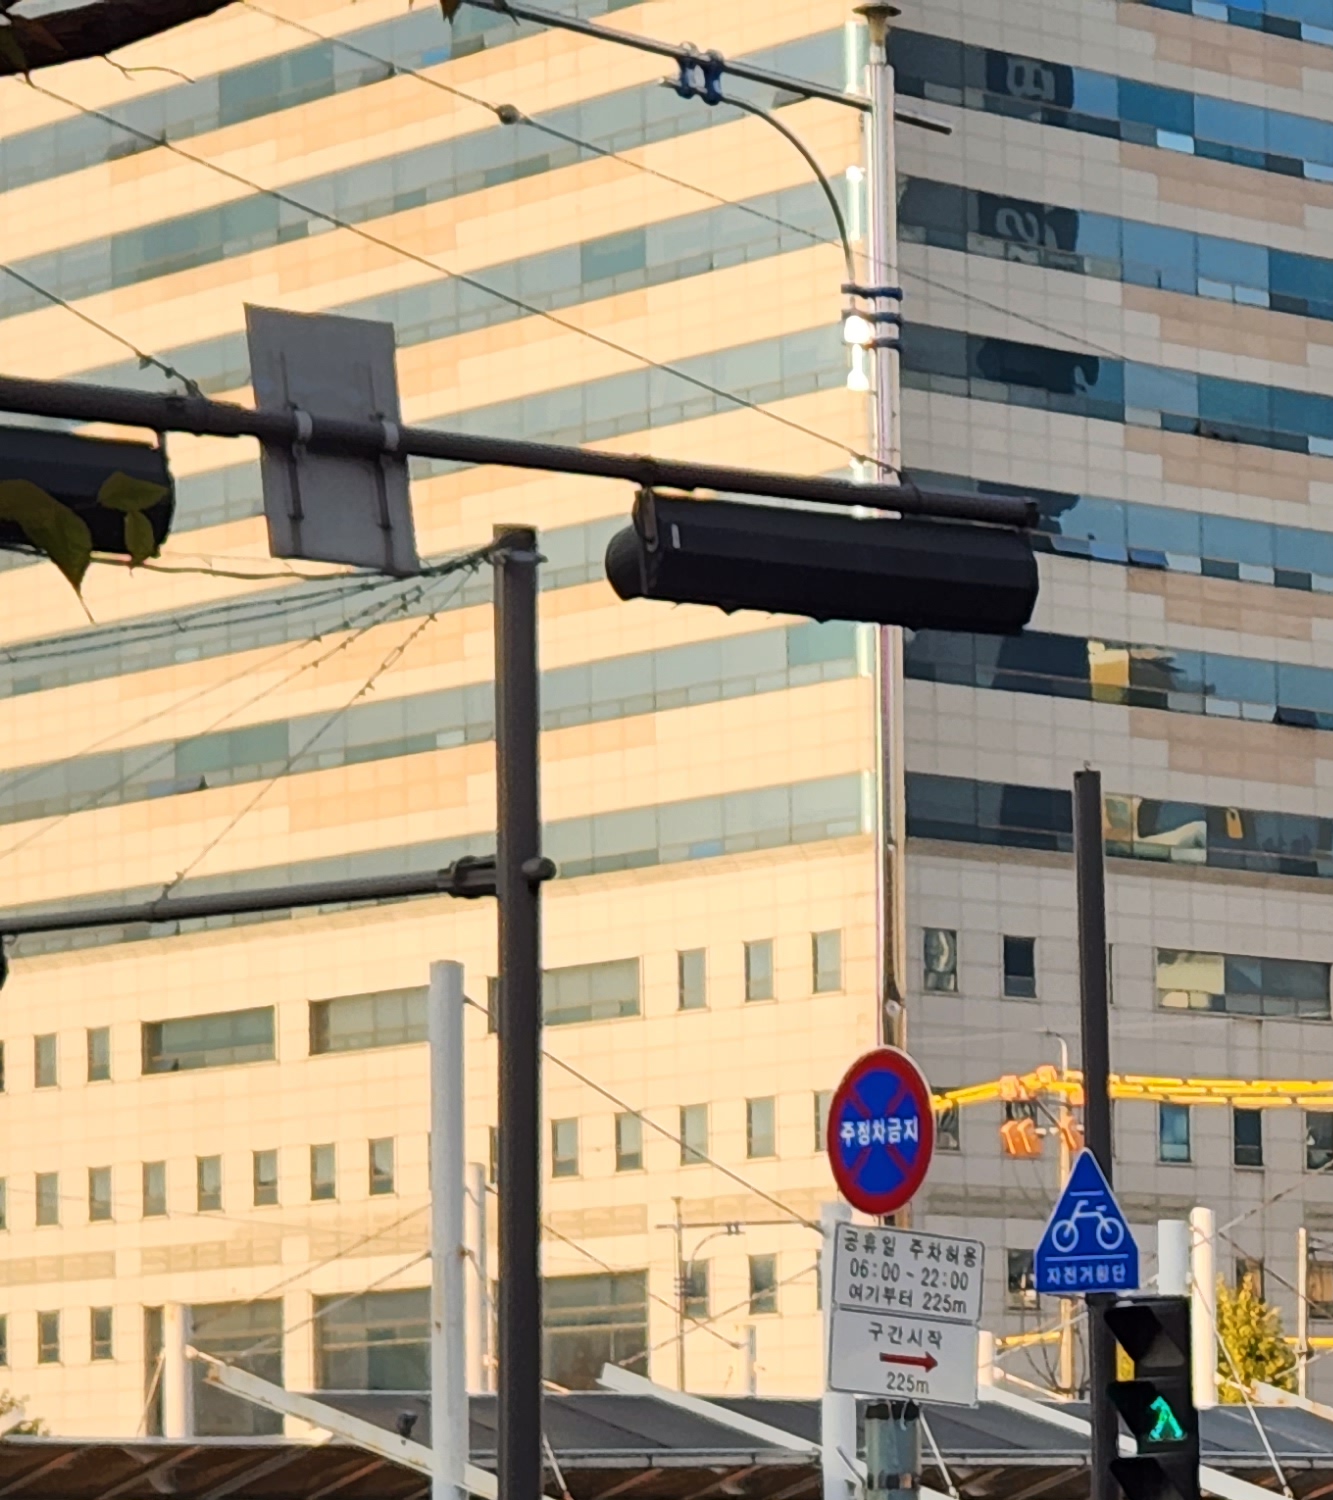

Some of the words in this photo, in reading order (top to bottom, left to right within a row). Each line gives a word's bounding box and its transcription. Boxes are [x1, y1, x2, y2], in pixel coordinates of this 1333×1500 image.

[840, 1115, 918, 1147] 주정차금지
[844, 1229, 896, 1258] 공휴일
[909, 1238, 977, 1268] 주차허용
[850, 1257, 900, 1283] 06:00
[920, 1267, 969, 1291] 22:00
[1046, 1263, 1126, 1286] 자전거횡단
[848, 1283, 913, 1308] 여기부터
[922, 1292, 967, 1314] 225m
[868, 1321, 942, 1350] 구간시작
[886, 1371, 930, 1394] 225m
